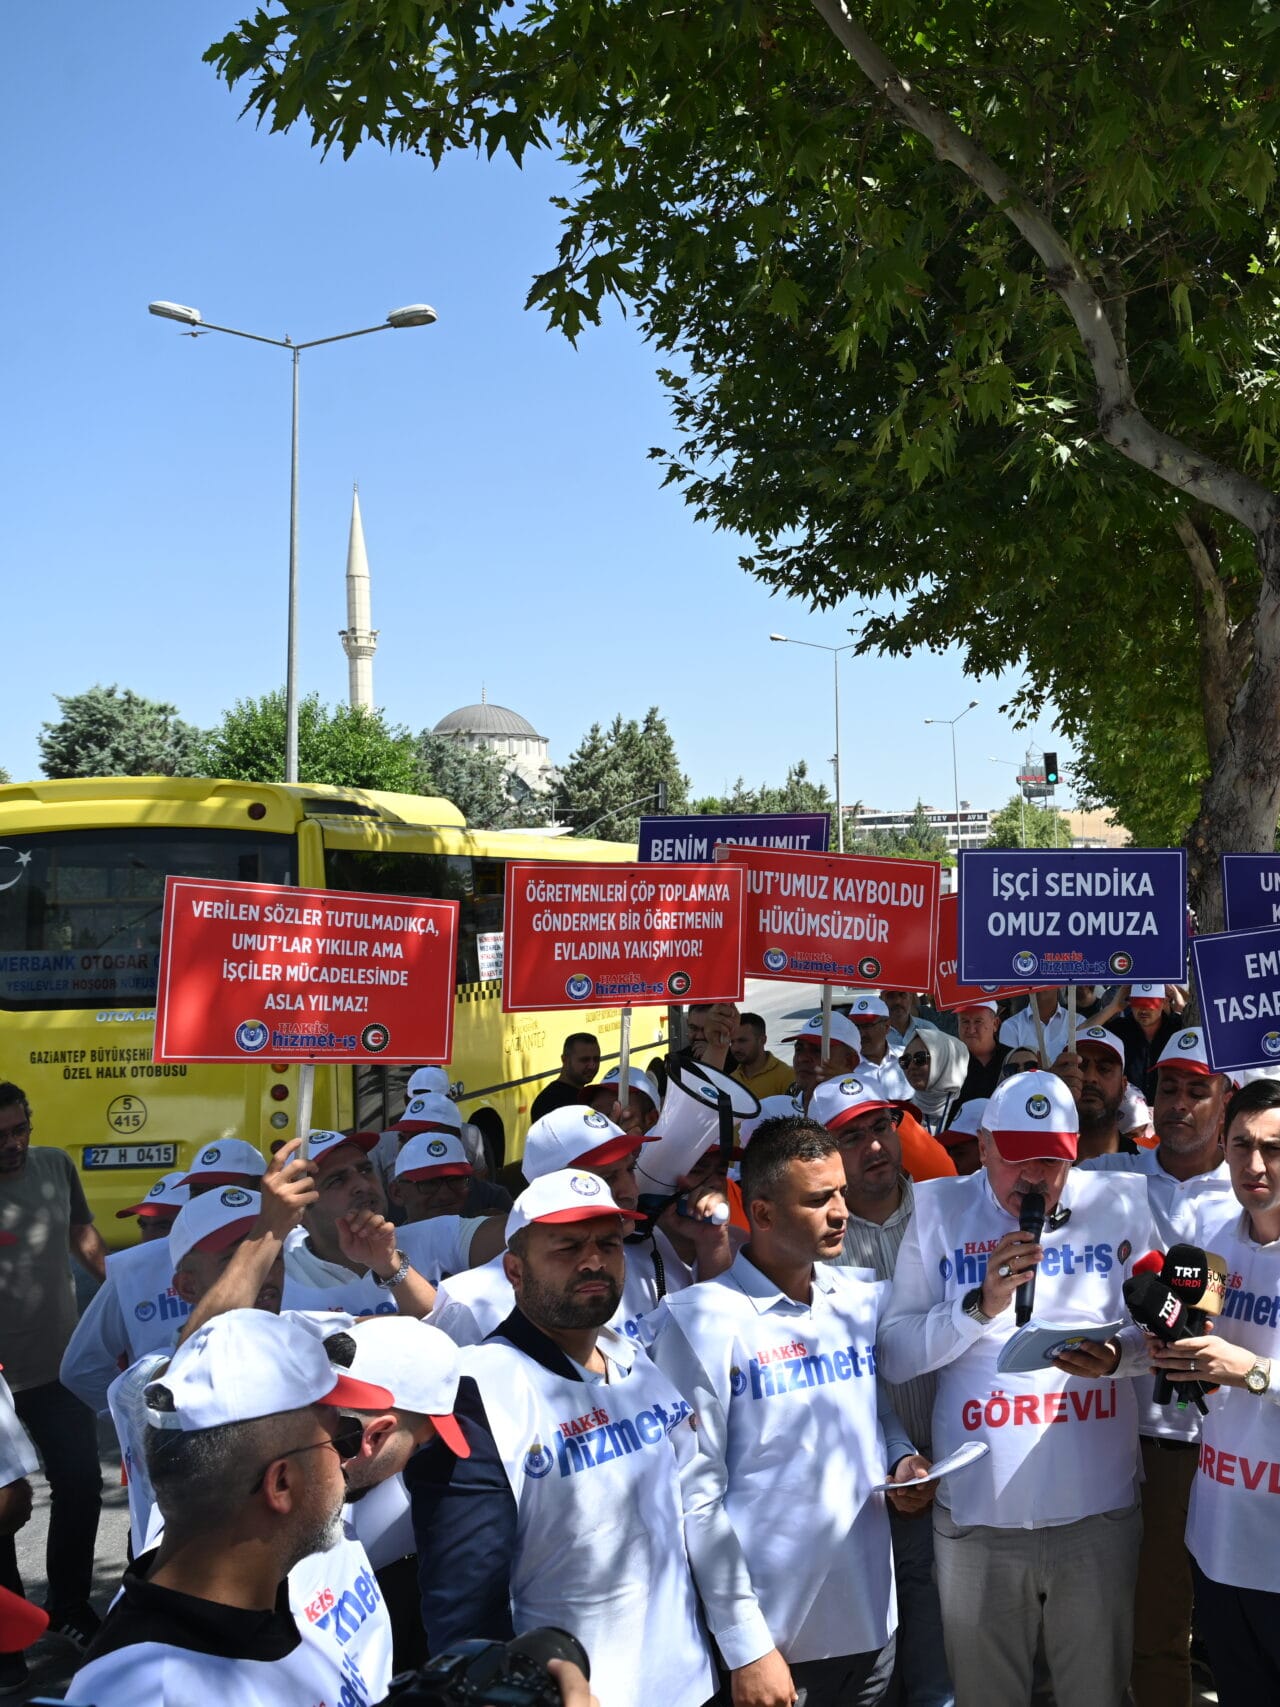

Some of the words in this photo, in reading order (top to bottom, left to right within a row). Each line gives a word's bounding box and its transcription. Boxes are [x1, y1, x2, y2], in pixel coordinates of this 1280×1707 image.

[651, 834, 707, 862] BENİM
[526, 881, 627, 902] ÖĞRETMENLERİ
[631, 883, 655, 905] ÇÖP
[659, 884, 730, 901] TOPLAMAYA
[747, 870, 828, 900] UT’UMUZ
[833, 877, 924, 908] KAYBOLDU
[992, 868, 1038, 901] İŞÇİ
[1045, 868, 1154, 898] SENDİKA
[192, 899, 260, 922] VERİLEN
[263, 905, 322, 927] SÖZLER
[326, 911, 440, 937] TUTULMADIKÇA,
[532, 912, 615, 931] GÖNDERMEK
[619, 910, 640, 930] BİR
[644, 908, 723, 930] ÖĞRETMENİN
[759, 905, 888, 943] HÜKÜMSÜZDÜR
[987, 911, 1061, 936] OMUZ
[1067, 911, 1159, 936] OMUZA
[231, 933, 311, 954] UMUT’LAR
[316, 938, 368, 957] YIKILIR
[372, 942, 403, 959] AMA
[554, 941, 620, 961] EVLADINA
[624, 940, 703, 961] YAKIŞMIYOR!
[80, 954, 148, 970] OTOGAR
[223, 959, 282, 983] İŞÇİLER
[286, 962, 408, 986] MÜCADELESİNDE
[265, 993, 304, 1011] ASLA
[309, 995, 368, 1013] YILMAZ!
[272, 1032, 357, 1050] hizmet-iş
[63, 1066, 92, 1079] ÖZEL
[96, 1066, 126, 1078] HALK
[123, 1098, 132, 1110] 5
[114, 1115, 140, 1126] 415
[92, 1150, 108, 1163] 27
[119, 1149, 126, 1162] H
[137, 1147, 172, 1161] 0415
[965, 1240, 998, 1254] HAK
[954, 1244, 1113, 1286] hiet-iş
[1175, 1266, 1201, 1278] TRT
[1159, 1292, 1177, 1319] TRT
[962, 1381, 1116, 1431] GÖREVLİ
[559, 1407, 609, 1437] HAK-İŞ
[304, 1588, 335, 1623] K-İŞ
